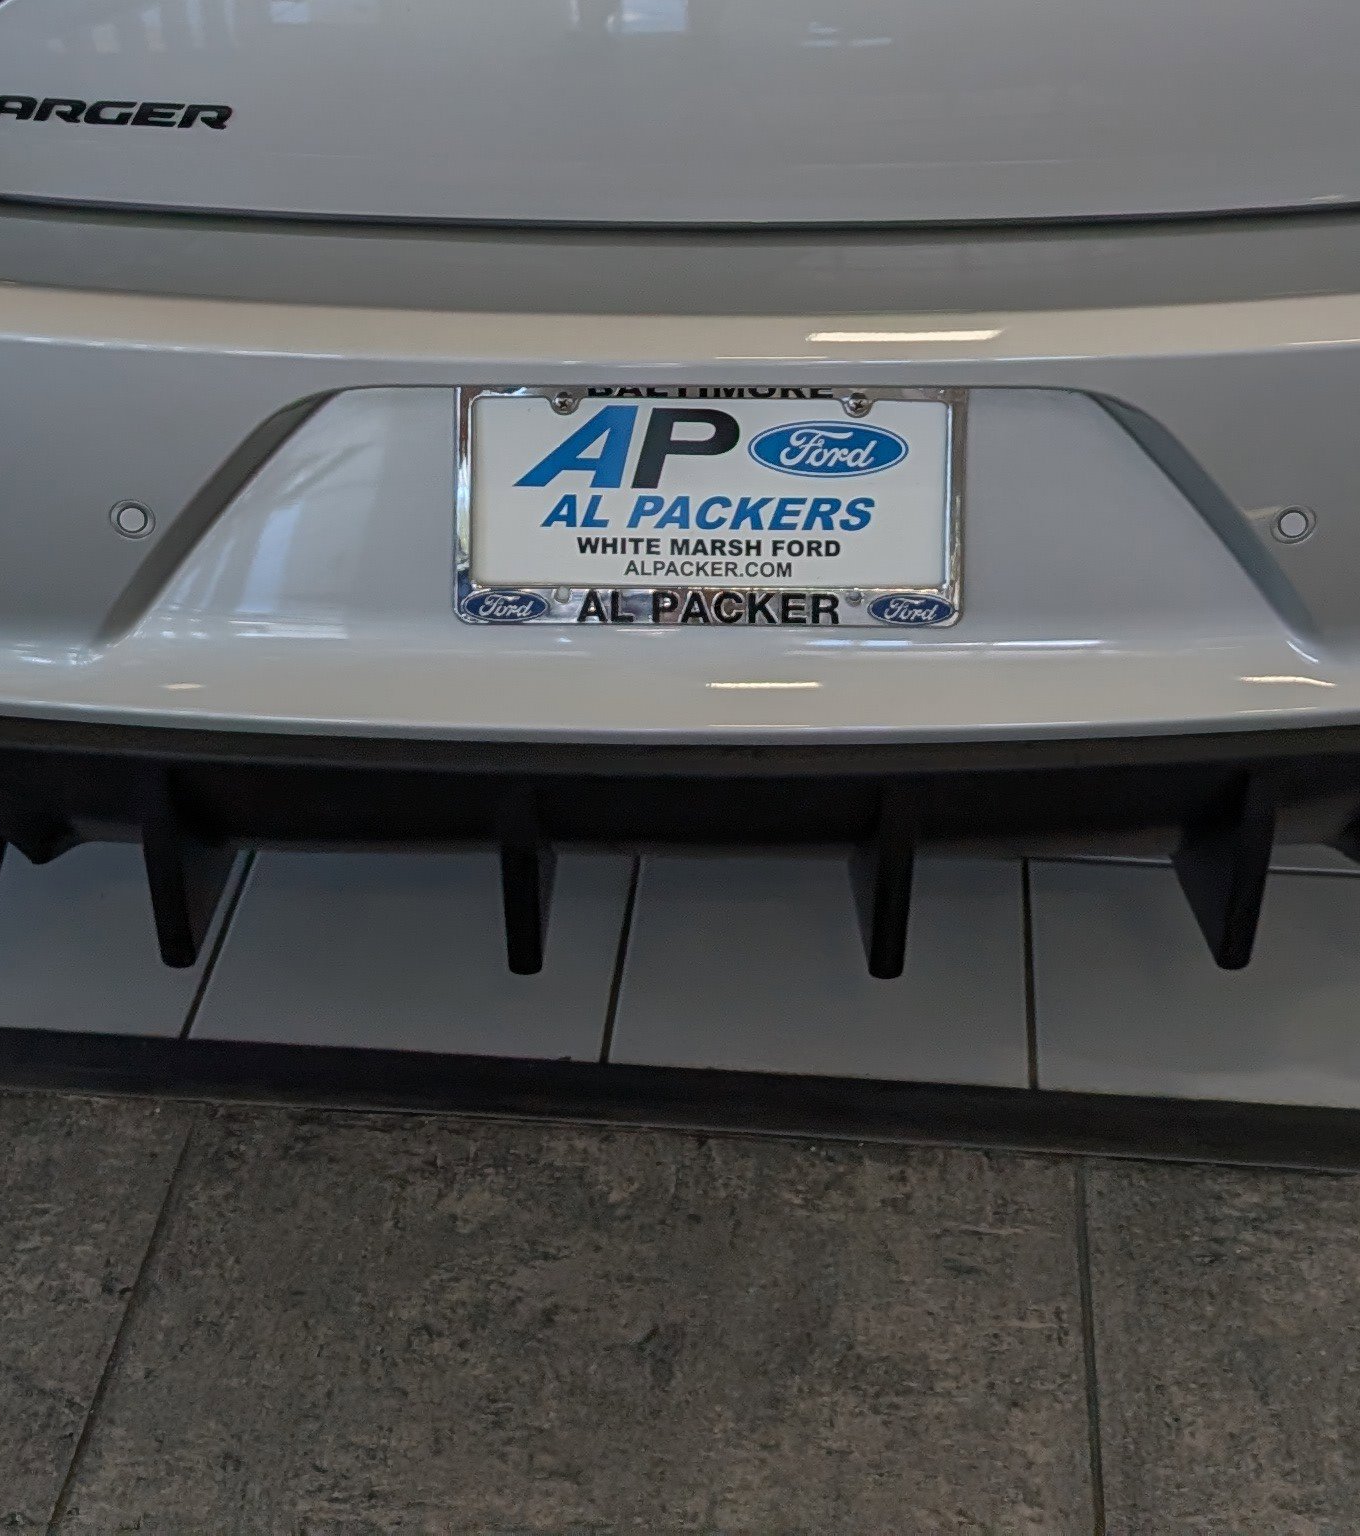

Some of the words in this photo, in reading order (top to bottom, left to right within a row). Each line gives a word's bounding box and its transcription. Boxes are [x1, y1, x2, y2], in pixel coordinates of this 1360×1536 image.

[512, 404, 740, 489] AP
[779, 428, 878, 468] Ford
[540, 493, 610, 528] AL
[626, 495, 876, 532] PACKERS
[577, 536, 661, 555] WHITE
[670, 538, 762, 556] MARSH
[771, 539, 841, 557] FORD
[624, 560, 792, 578] ALPACKER.COM
[478, 594, 534, 618] Ford
[576, 590, 635, 623] AL
[651, 590, 840, 625] PACKER
[883, 598, 940, 622] Ford
